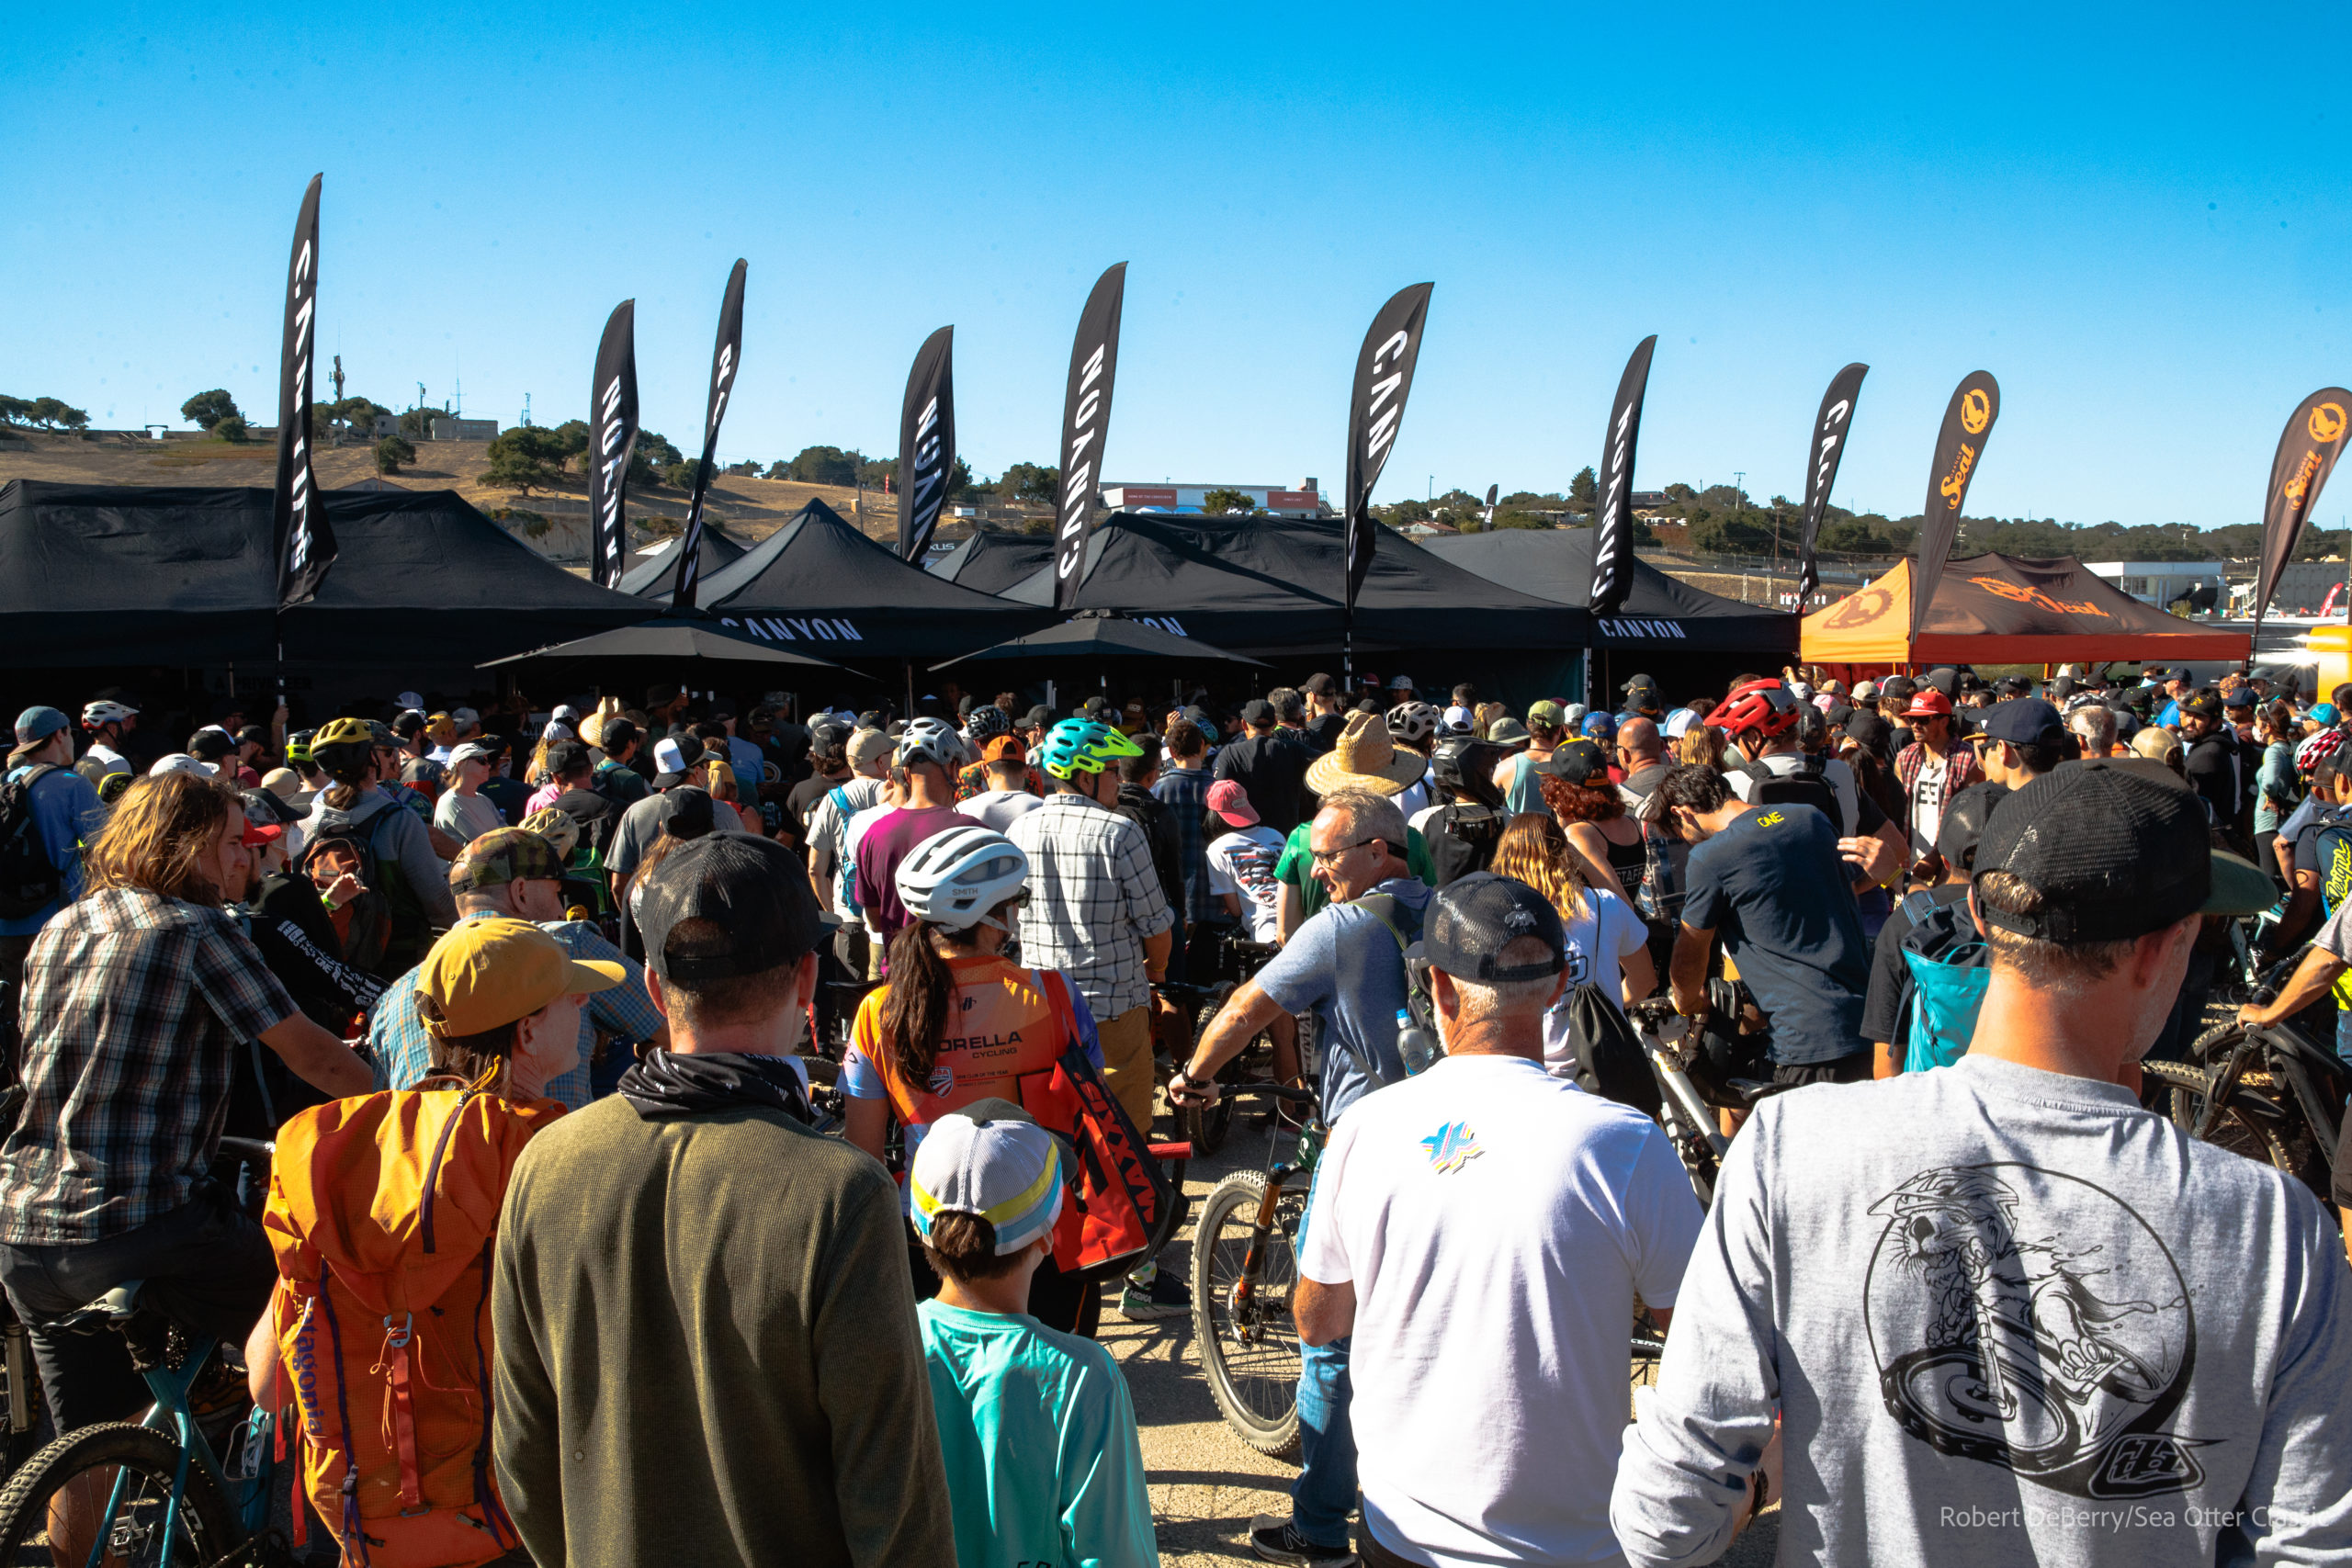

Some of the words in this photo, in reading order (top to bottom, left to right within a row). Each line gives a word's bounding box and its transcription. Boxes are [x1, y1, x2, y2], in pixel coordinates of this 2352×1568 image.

[1058, 343, 1106, 579] CANYON
[1940, 443, 1974, 510] Seal
[1591, 402, 1632, 598] CANYON
[928, 543, 956, 551] XUS
[1599, 618, 1686, 638] CANYON
[1757, 811, 1785, 828] ONE
[952, 886, 978, 897] SMITH
[939, 1031, 1023, 1053] ORELLA
[972, 1046, 1019, 1059] CYCLING
[1080, 1081, 1157, 1224] MAXXIS
[292, 1308, 325, 1435] atagonia
